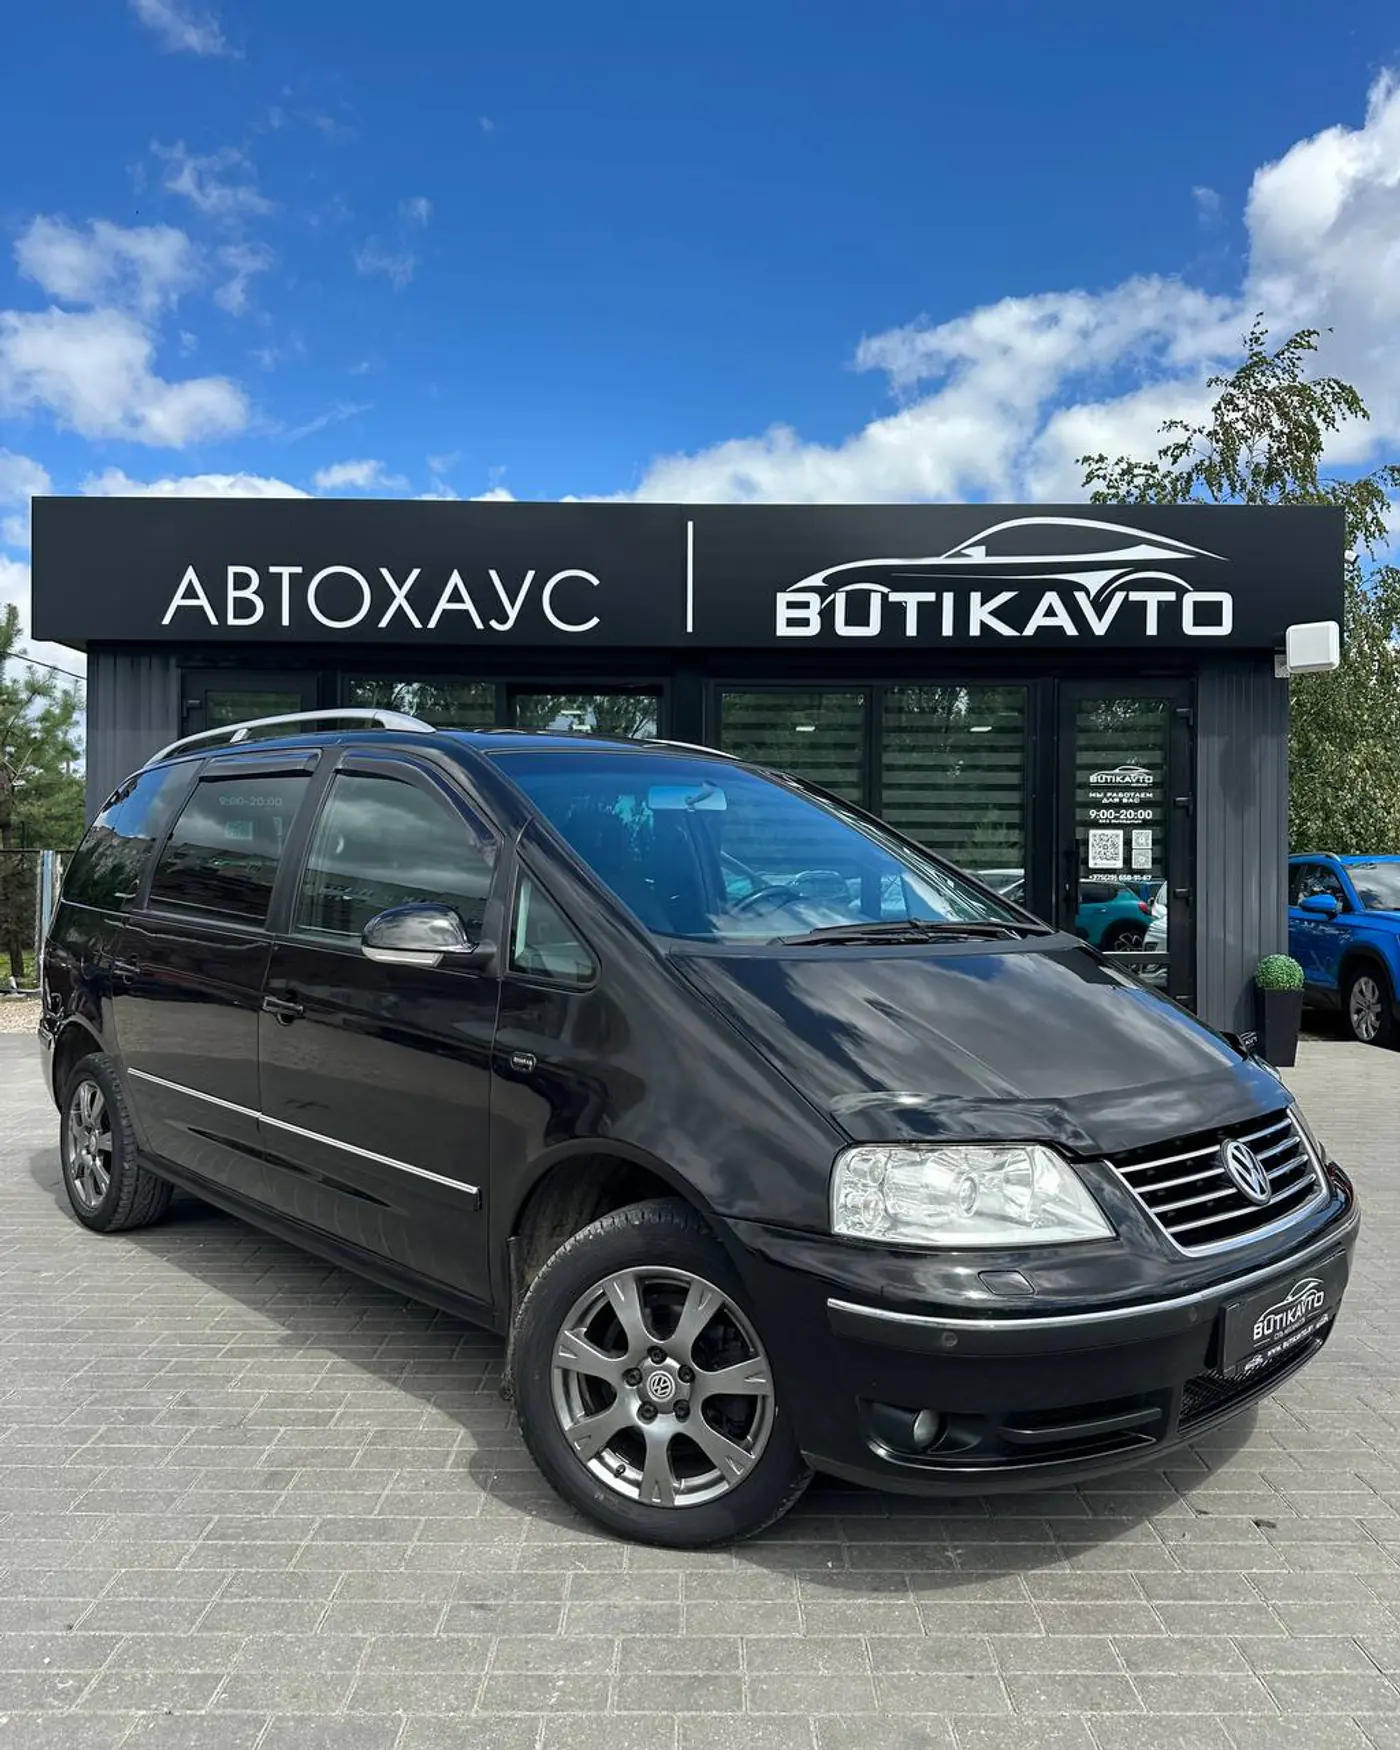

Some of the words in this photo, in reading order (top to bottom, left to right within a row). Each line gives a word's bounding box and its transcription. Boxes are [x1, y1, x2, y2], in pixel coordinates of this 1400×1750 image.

[161, 564, 600, 632] АВТОХАУС
[775, 590, 1233, 637] BUTIKAVTO
[1090, 775, 1153, 783] BUTIKAVTO
[1090, 809, 1153, 819] 9:00-20:00
[1253, 1291, 1325, 1340] BUTIKAVTO
